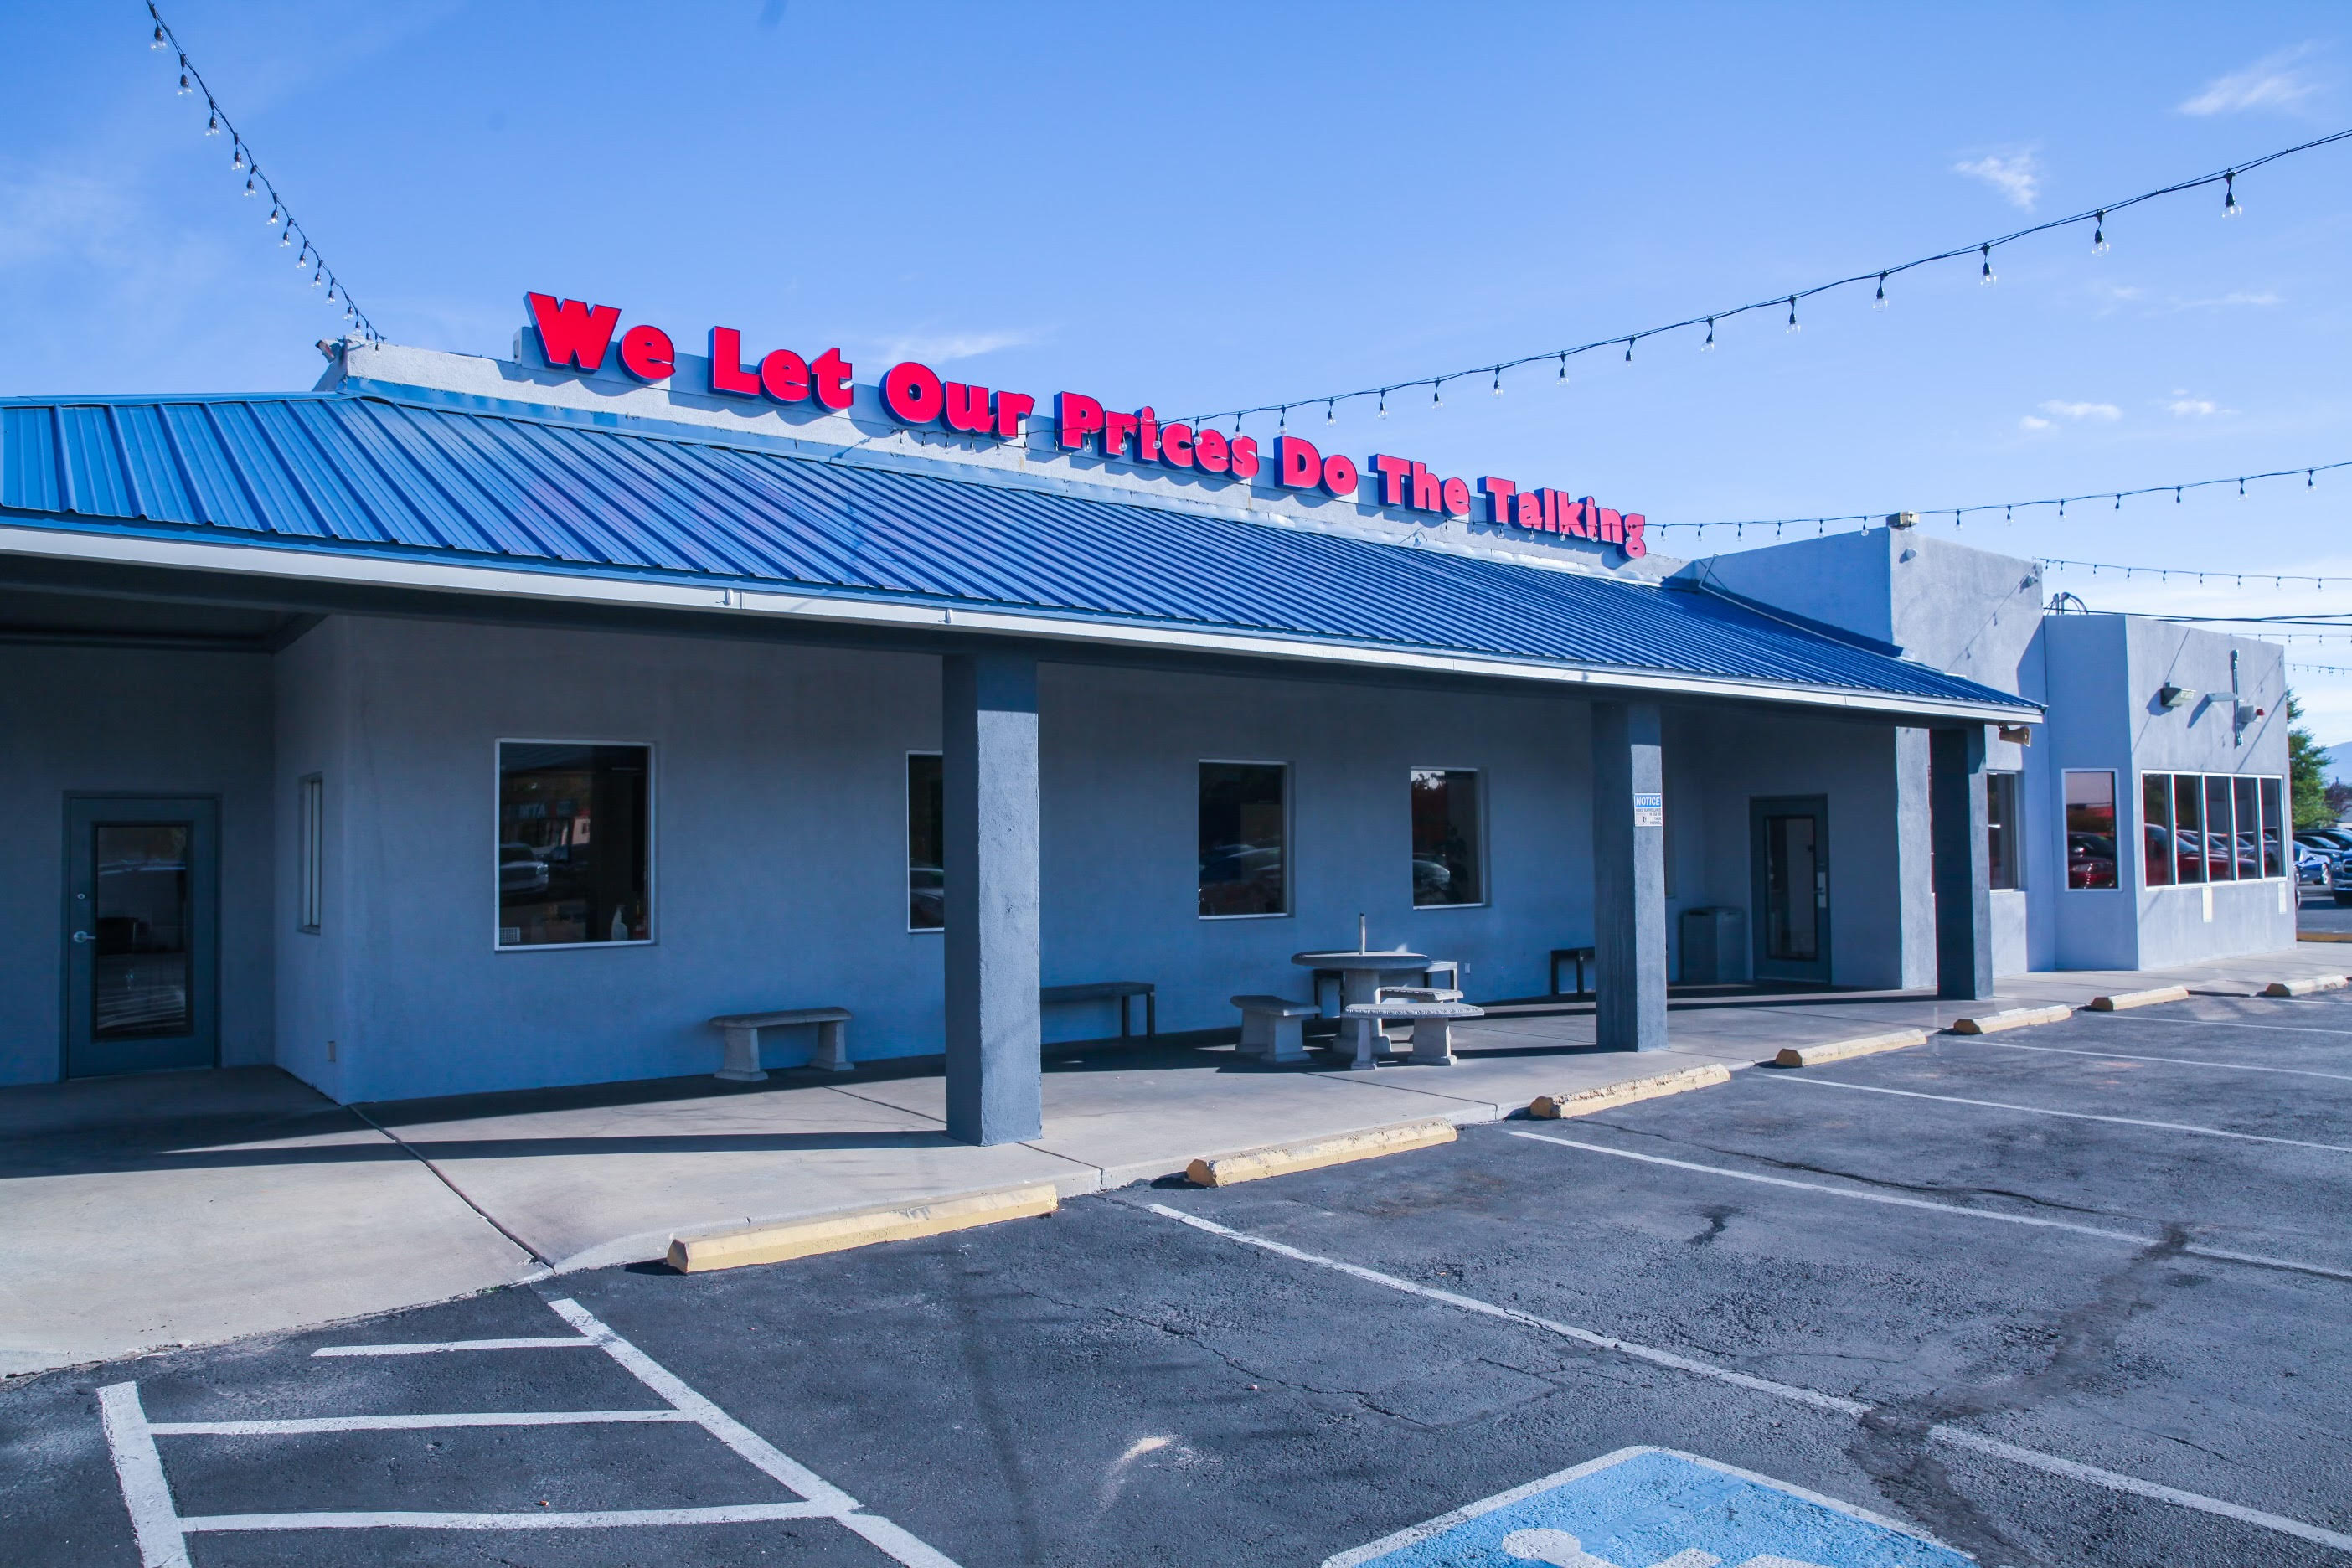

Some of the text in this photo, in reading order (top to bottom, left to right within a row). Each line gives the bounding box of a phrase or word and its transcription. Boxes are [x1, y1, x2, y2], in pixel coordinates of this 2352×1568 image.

[526, 292, 1646, 557] We Let Our Prices Do The Talking
[1636, 797, 1660, 806] NOTICE
